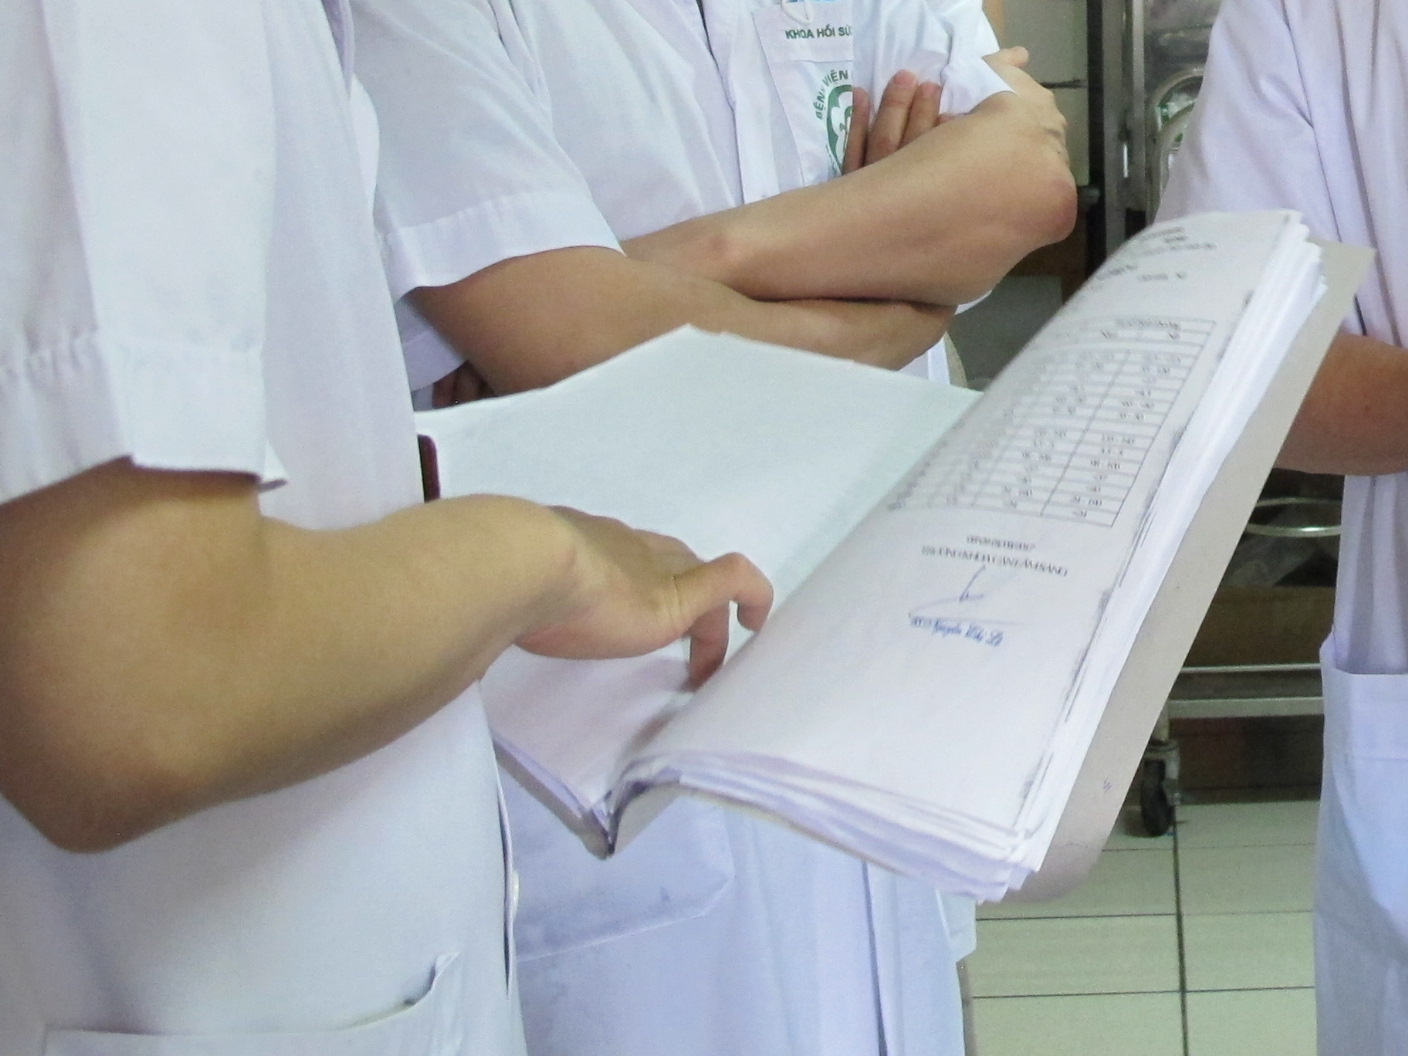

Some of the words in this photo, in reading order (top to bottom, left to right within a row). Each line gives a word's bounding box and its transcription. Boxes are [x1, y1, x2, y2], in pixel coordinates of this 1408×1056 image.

[785, 29, 814, 40] KHOA
[816, 24, 836, 38] HỒI
[821, 69, 849, 86] VIỆN
